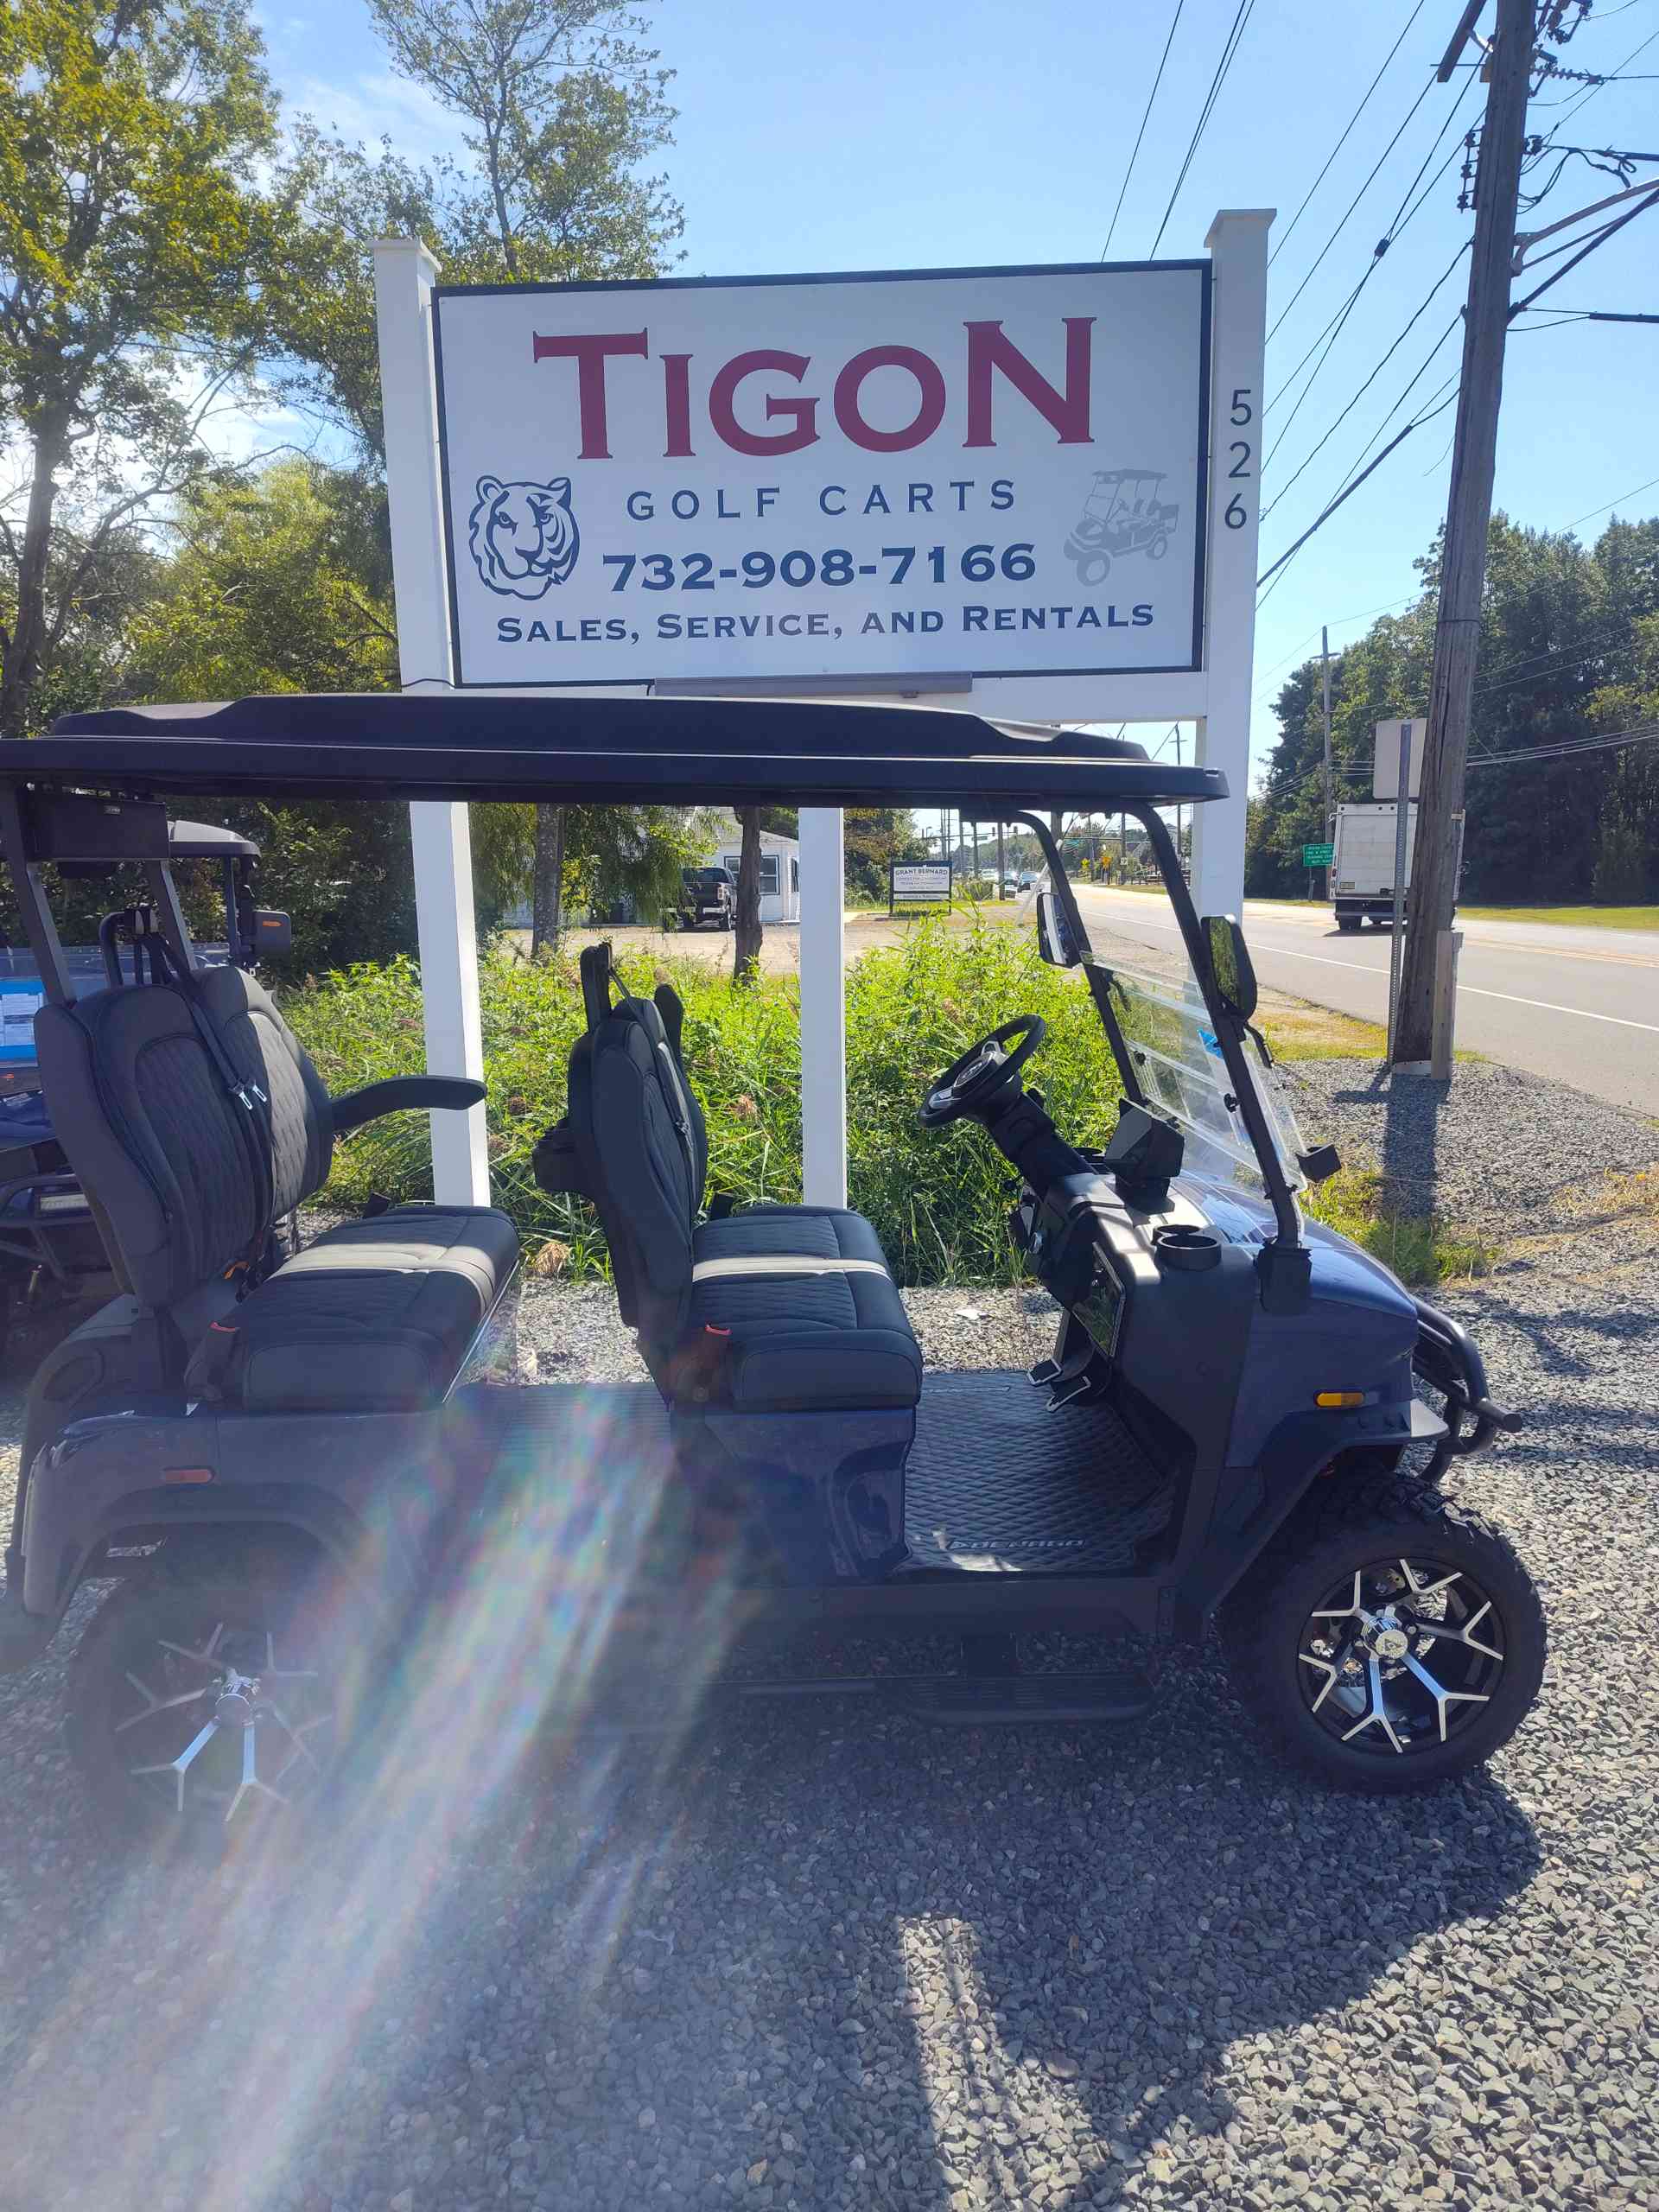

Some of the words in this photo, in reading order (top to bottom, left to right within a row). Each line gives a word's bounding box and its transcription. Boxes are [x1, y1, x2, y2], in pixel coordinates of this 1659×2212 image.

[627, 486, 781, 522] GOLF
[819, 480, 1015, 516] CARTS
[603, 543, 1036, 592] 732-908-7166
[961, 604, 1154, 632] RENTALS
